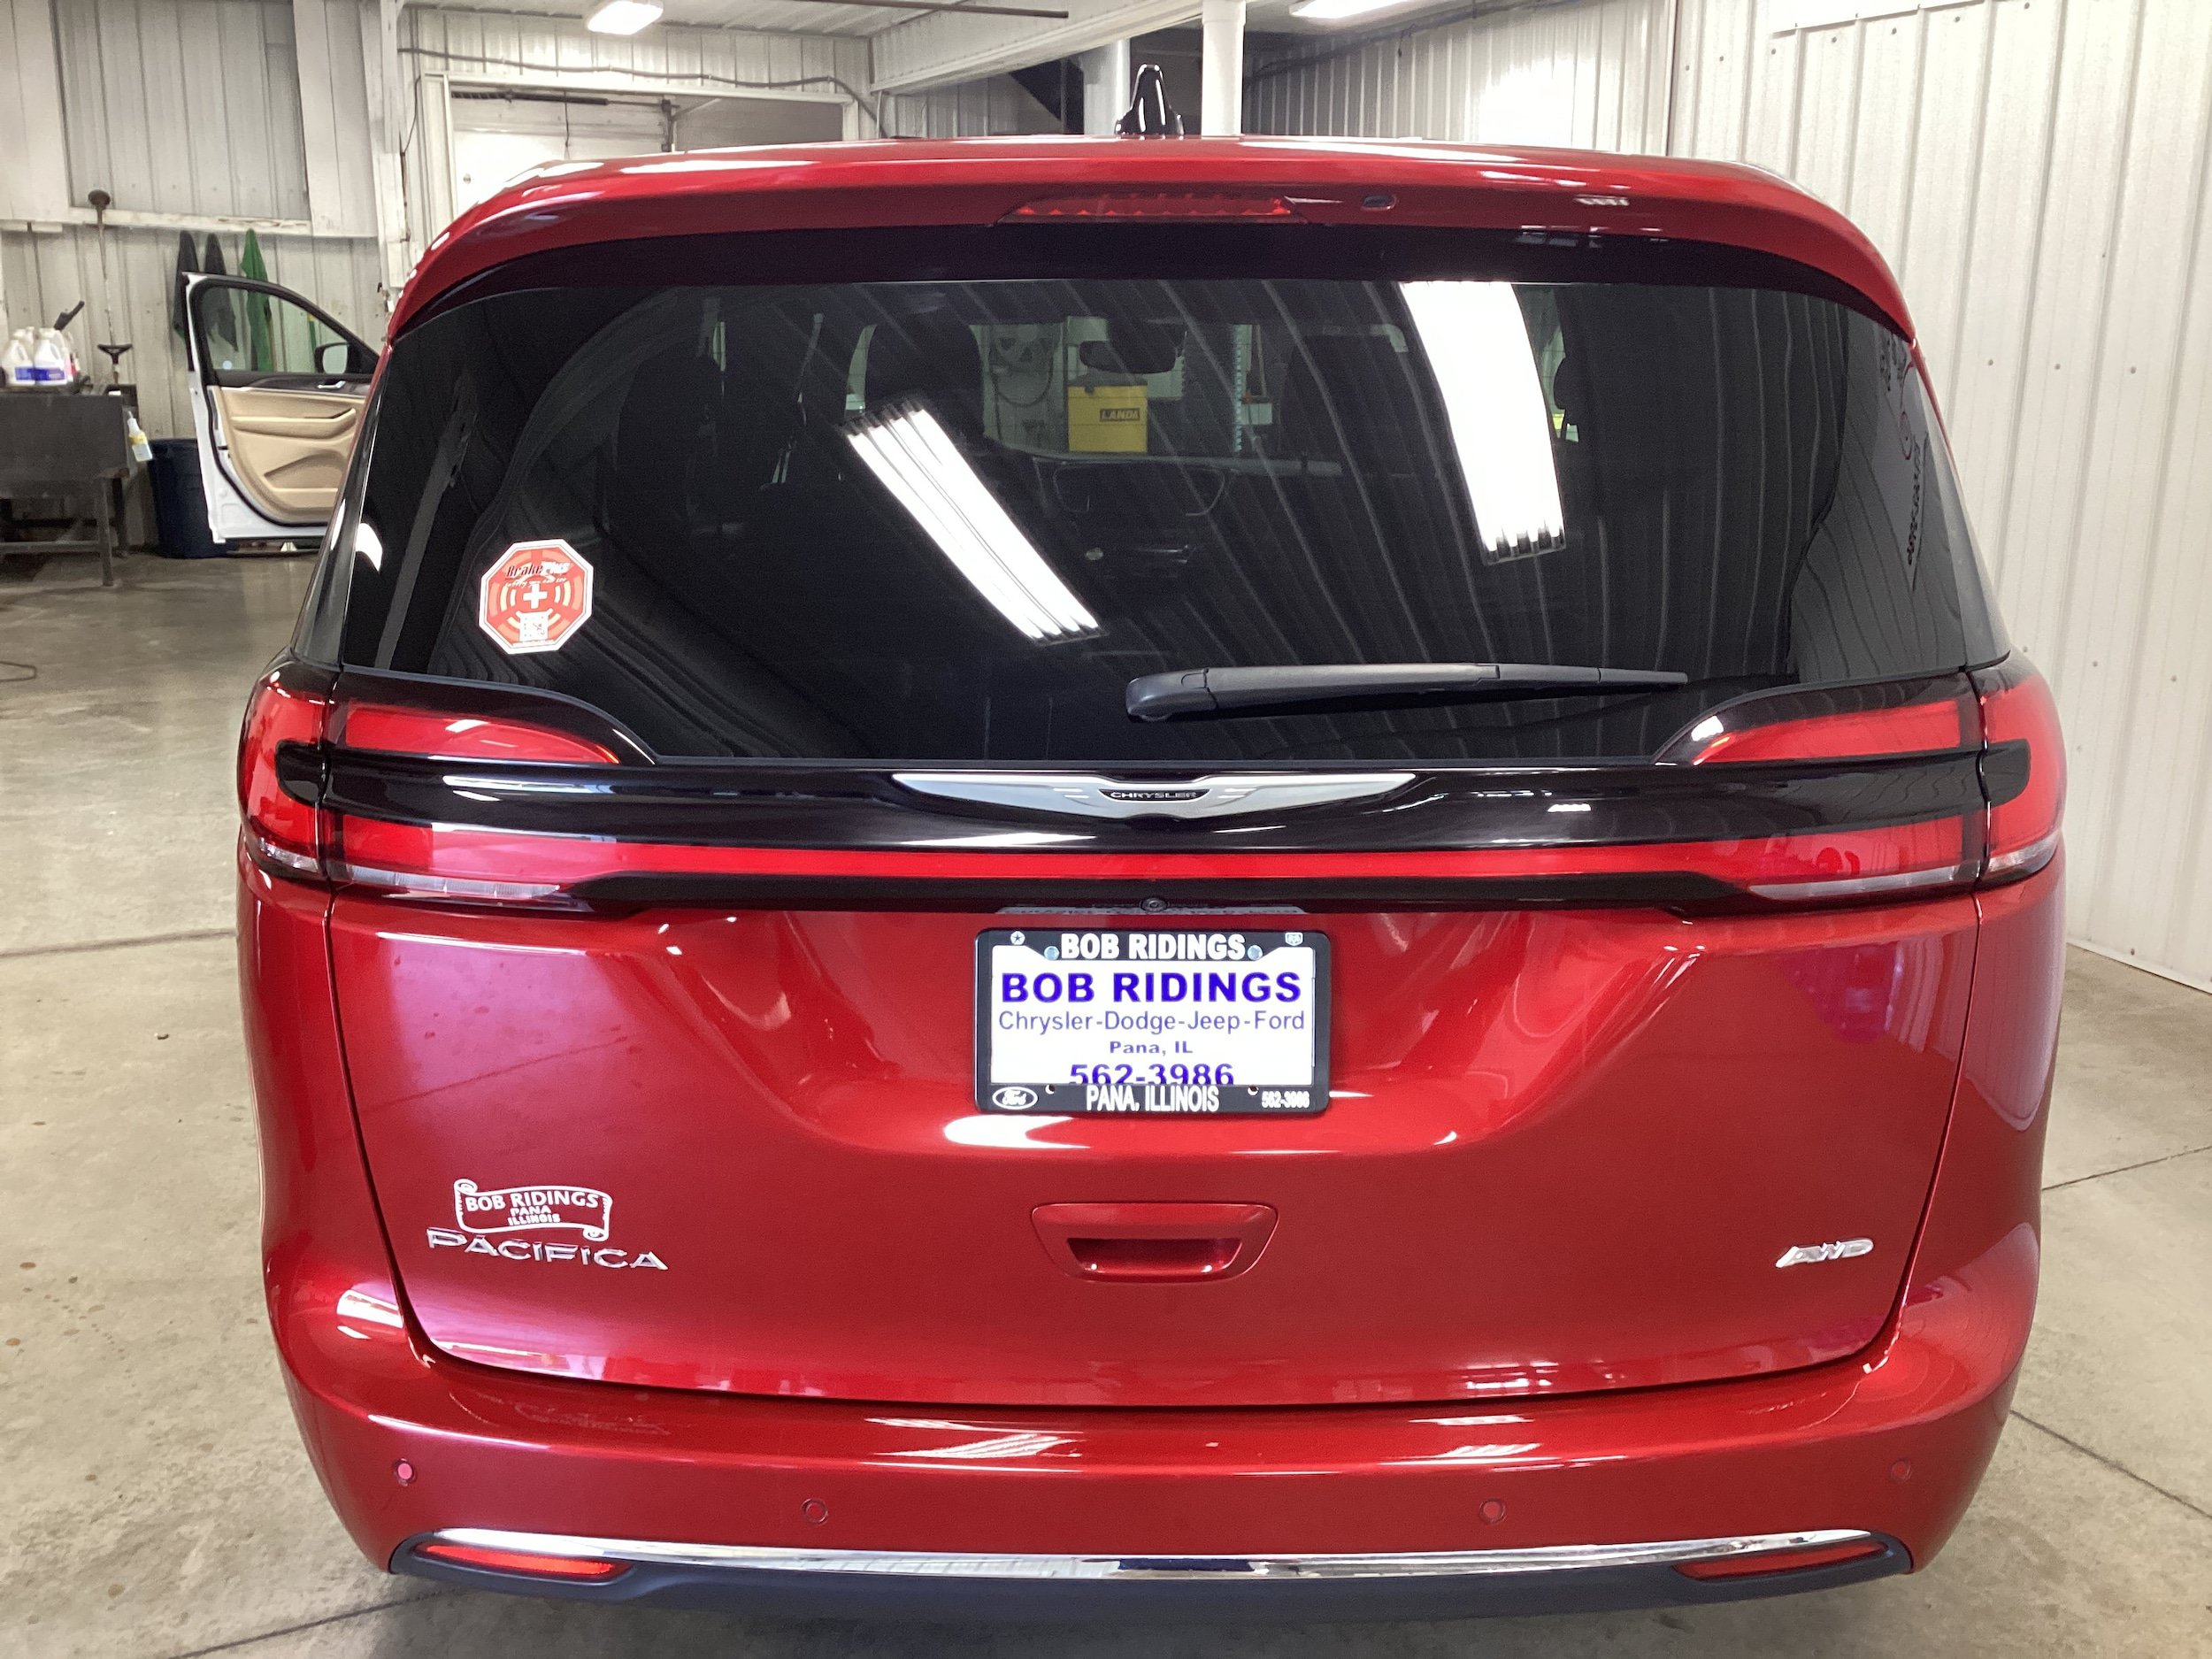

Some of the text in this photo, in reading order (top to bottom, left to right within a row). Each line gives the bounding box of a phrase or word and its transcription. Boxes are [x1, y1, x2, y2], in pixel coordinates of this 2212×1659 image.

[1101, 410, 1140, 420] LANDA
[1061, 933, 1246, 960] BOB RIDINGS
[1002, 972, 1302, 1002] BOB RIDINGS
[1110, 1041, 1194, 1056] Pana, IL
[1069, 1063, 1234, 1085] 562-3986
[1086, 1086, 1219, 1112] PANA, ILLINOIS
[465, 1190, 599, 1212] BOB RIDINGS
[510, 1205, 552, 1217] PANA
[507, 1213, 561, 1226] ILLINOIS
[426, 1226, 669, 1271] PACIFICA
[1775, 1238, 1874, 1269] AWD
